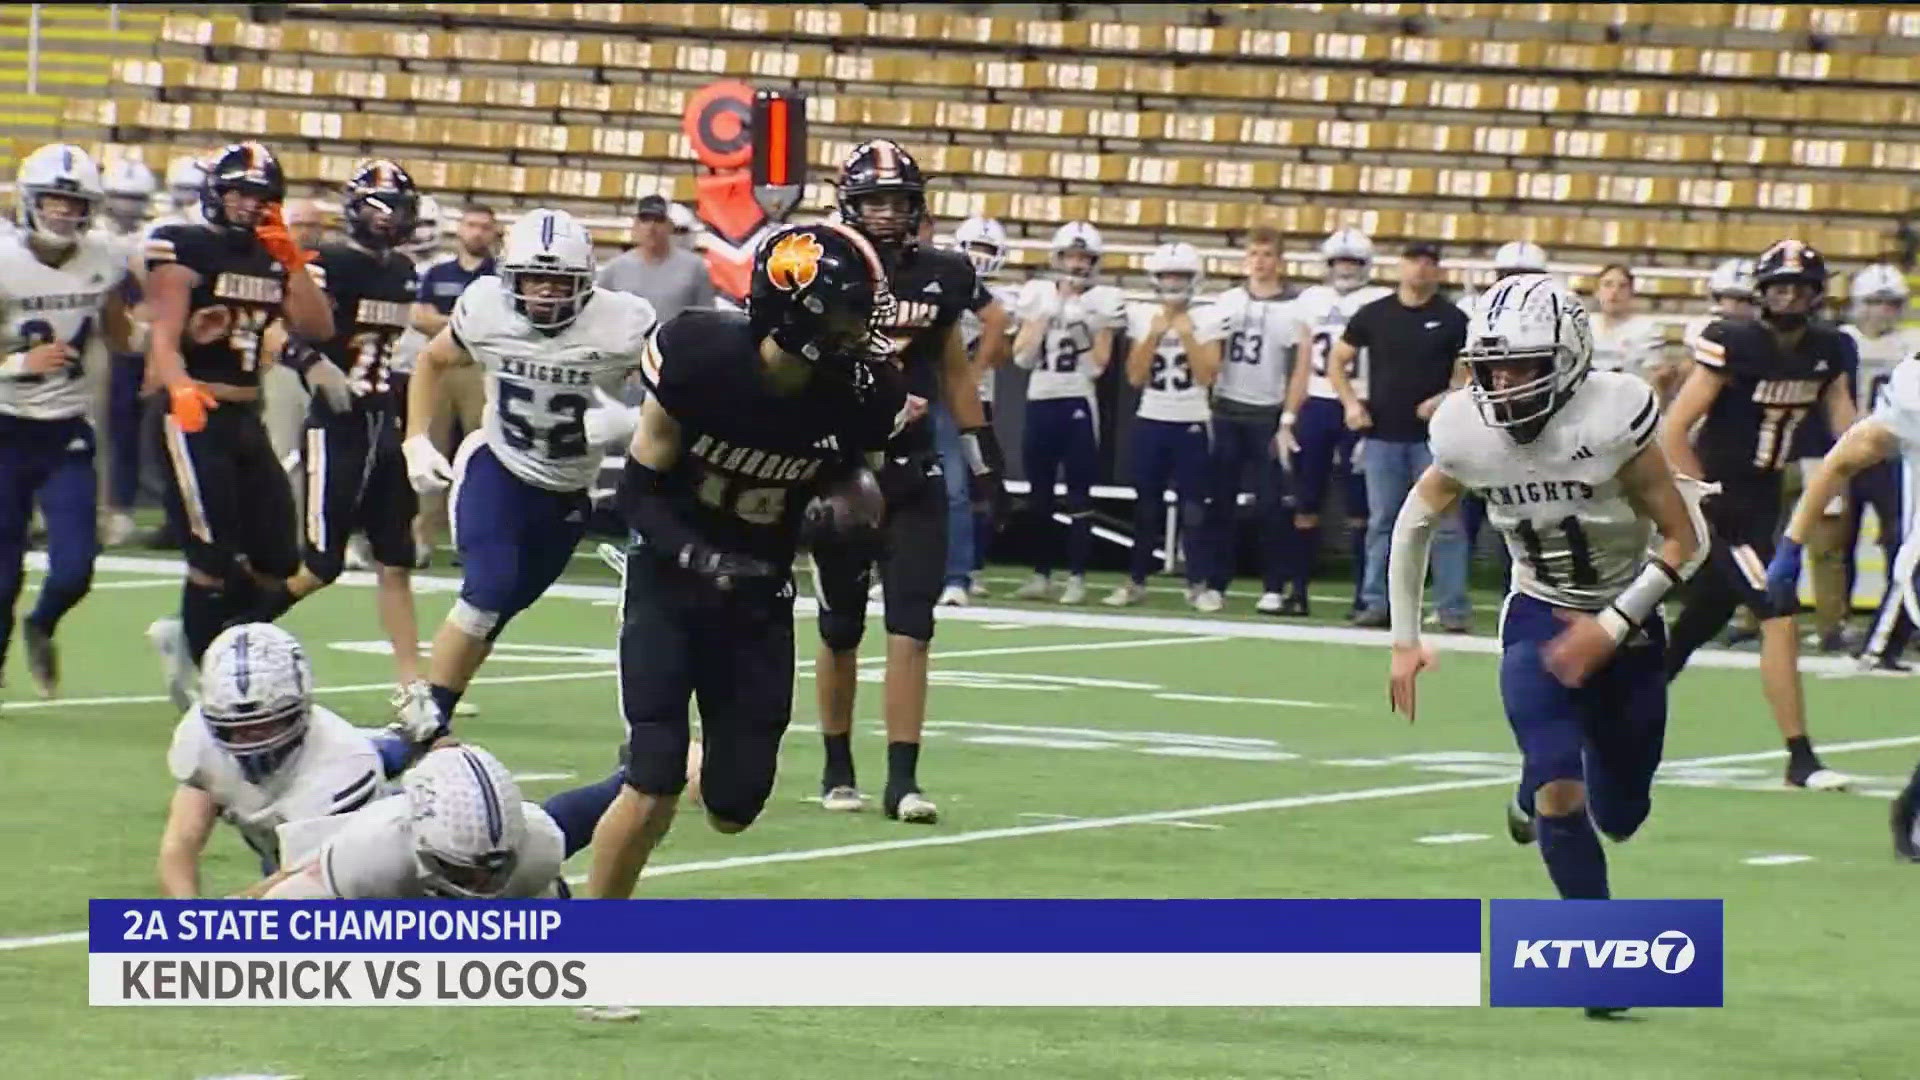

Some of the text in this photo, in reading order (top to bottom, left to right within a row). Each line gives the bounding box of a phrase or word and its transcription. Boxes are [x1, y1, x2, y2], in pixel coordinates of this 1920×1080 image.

[1230, 331, 1262, 365] 63
[500, 357, 592, 386] KNIGHTS
[1151, 353, 1193, 391] 23
[498, 378, 587, 460] 52
[1515, 514, 1599, 587] 11
